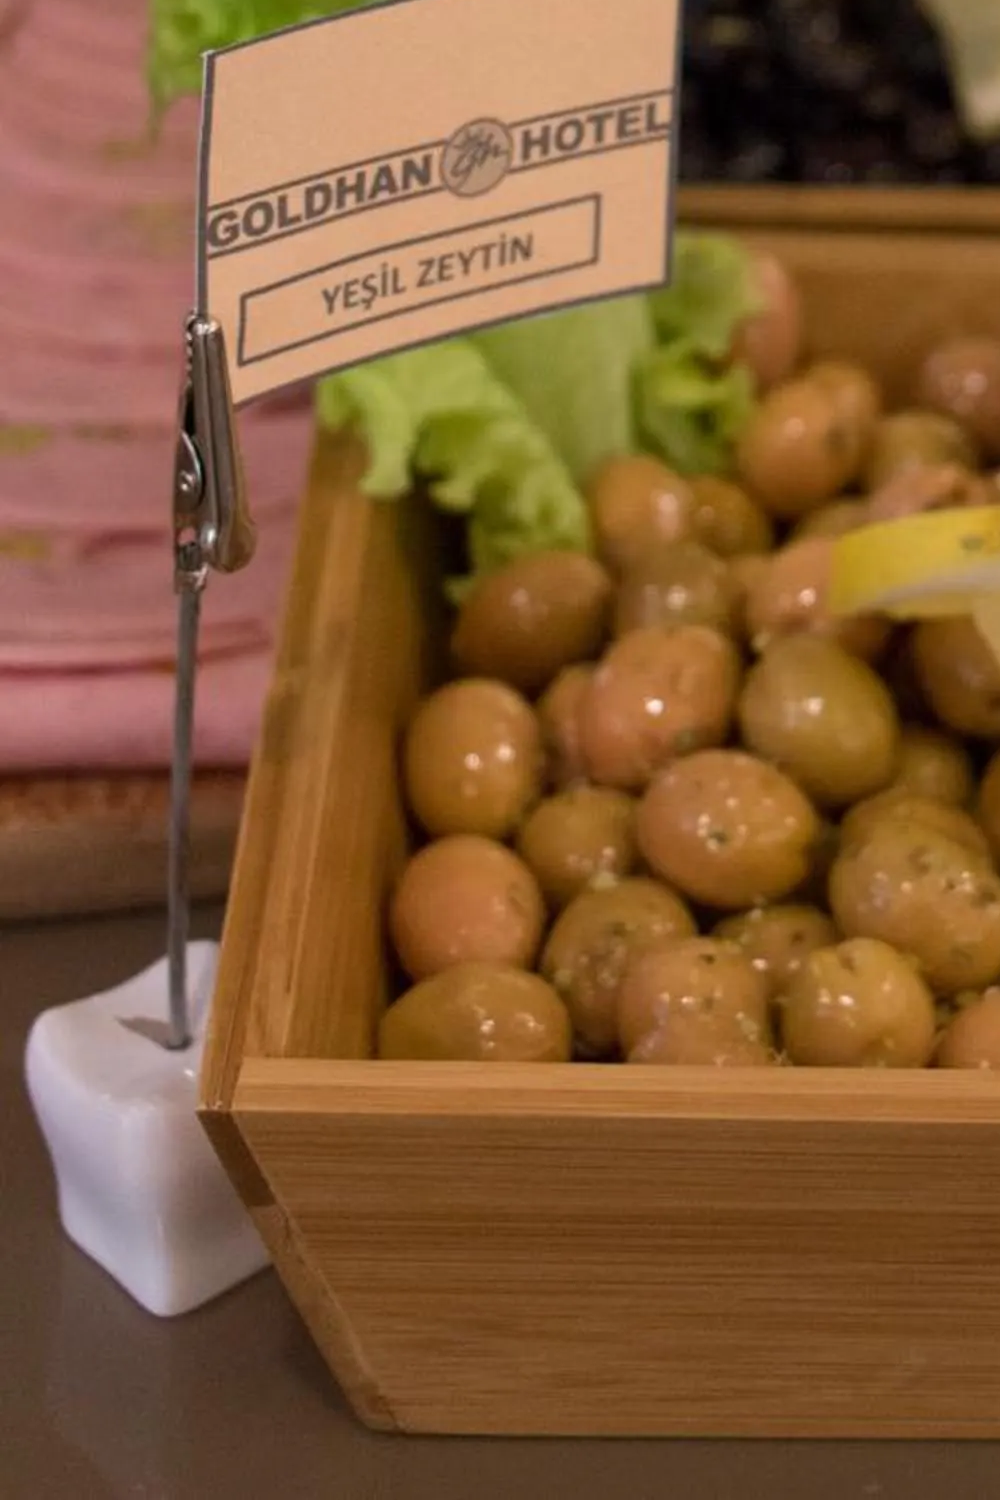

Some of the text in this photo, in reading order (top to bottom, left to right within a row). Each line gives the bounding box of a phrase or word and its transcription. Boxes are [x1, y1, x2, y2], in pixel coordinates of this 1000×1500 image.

[208, 102, 671, 248] GOLDHAN HOTEL
[321, 232, 535, 315] YEŞİL ZEYTİN
